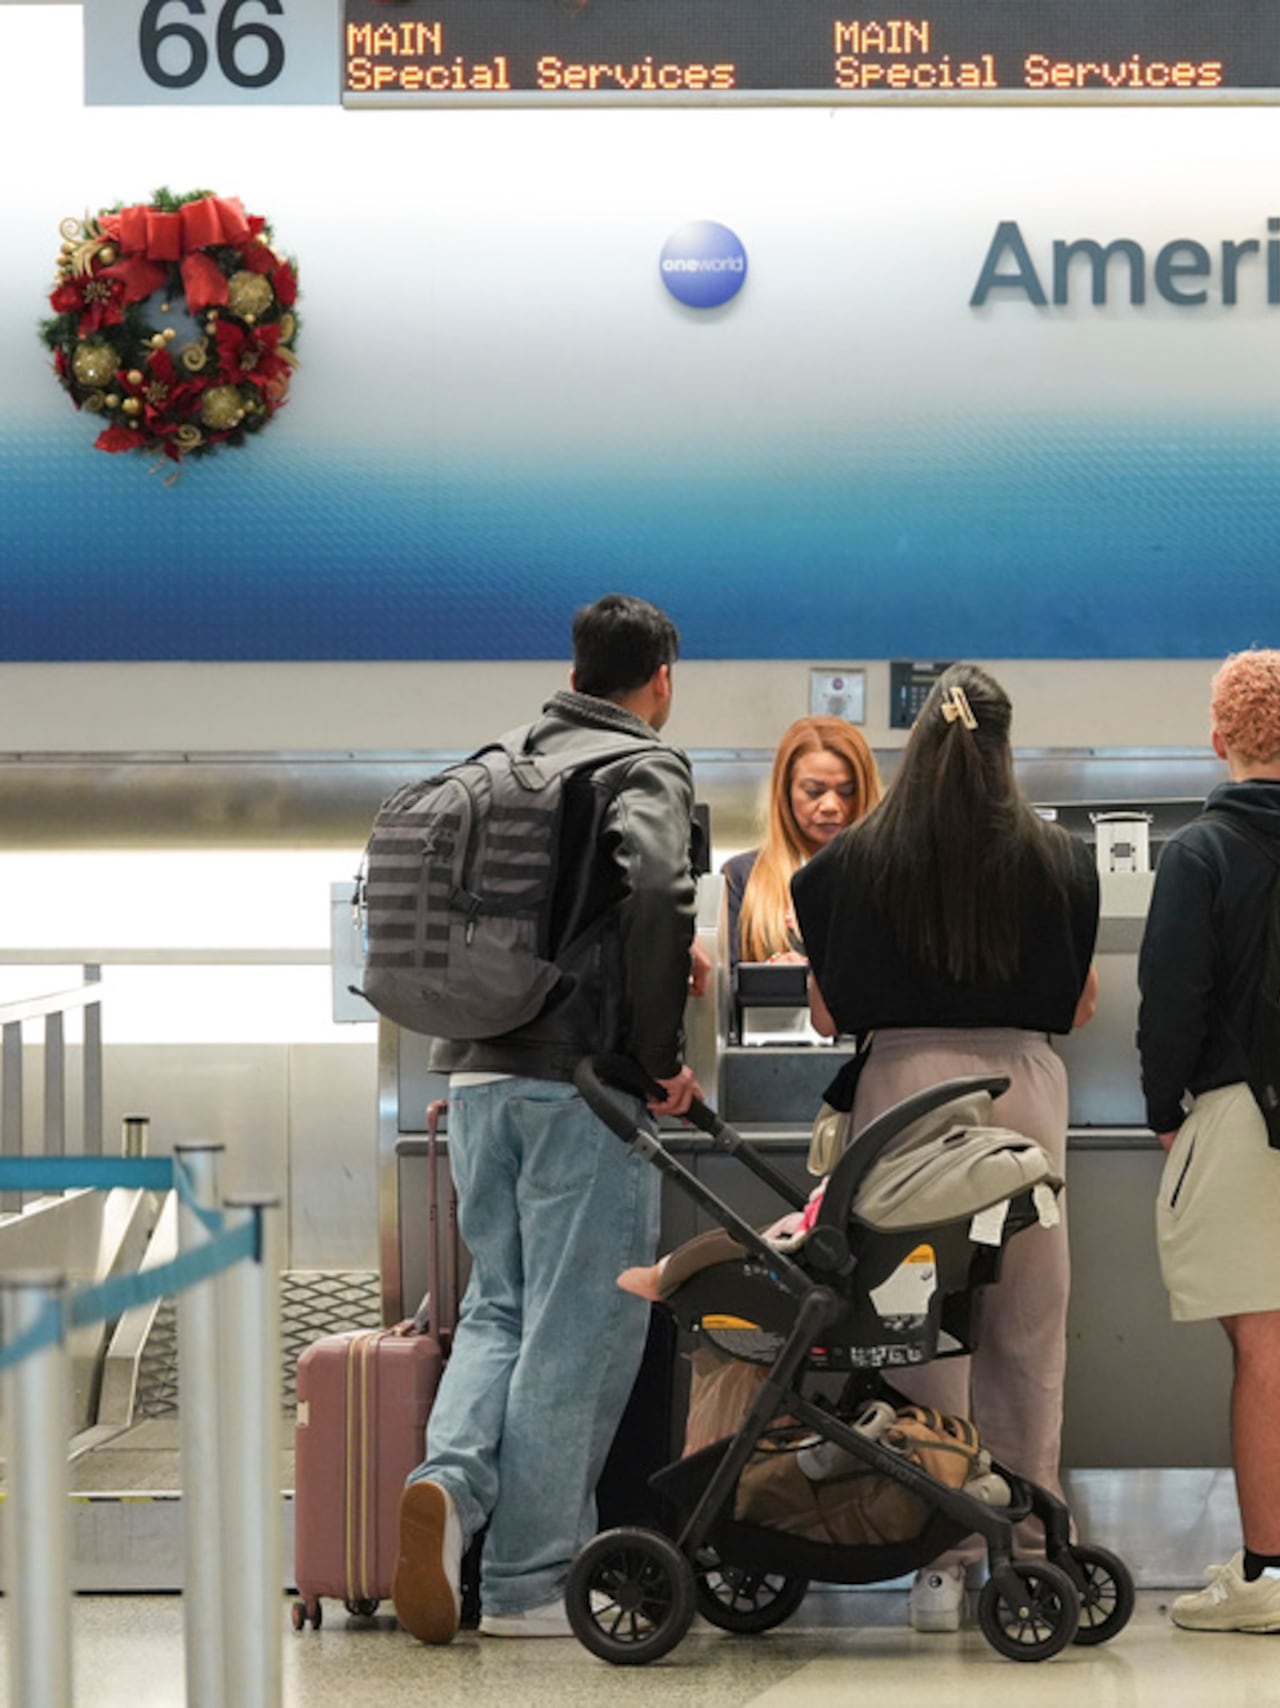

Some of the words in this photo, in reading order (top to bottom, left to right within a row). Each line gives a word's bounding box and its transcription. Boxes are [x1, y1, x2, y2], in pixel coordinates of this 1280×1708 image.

[139, 0, 286, 89] 66
[347, 22, 442, 56] MAIN
[834, 20, 930, 54] MAIN
[347, 56, 511, 90] Special
[537, 56, 735, 90] Services
[834, 54, 998, 88] Special
[1024, 54, 1222, 88] Services
[662, 256, 744, 272] oneworld
